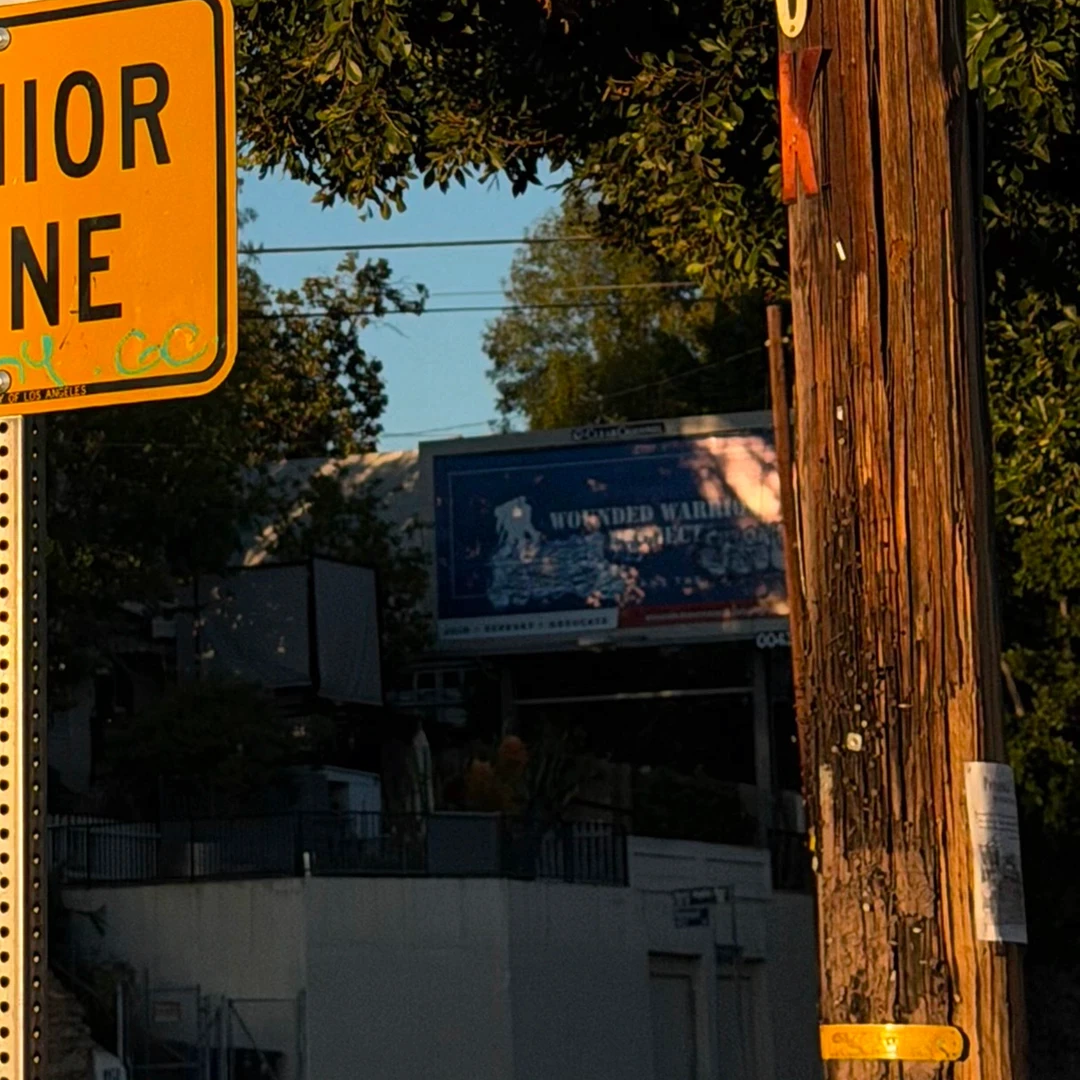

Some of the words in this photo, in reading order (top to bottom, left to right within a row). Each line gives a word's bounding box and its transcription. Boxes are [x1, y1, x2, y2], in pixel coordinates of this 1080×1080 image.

[7, 391, 20, 404] OF
[23, 389, 42, 402] LOS
[45, 384, 87, 399] ANGELES
[660, 497, 751, 522] WARRIO
